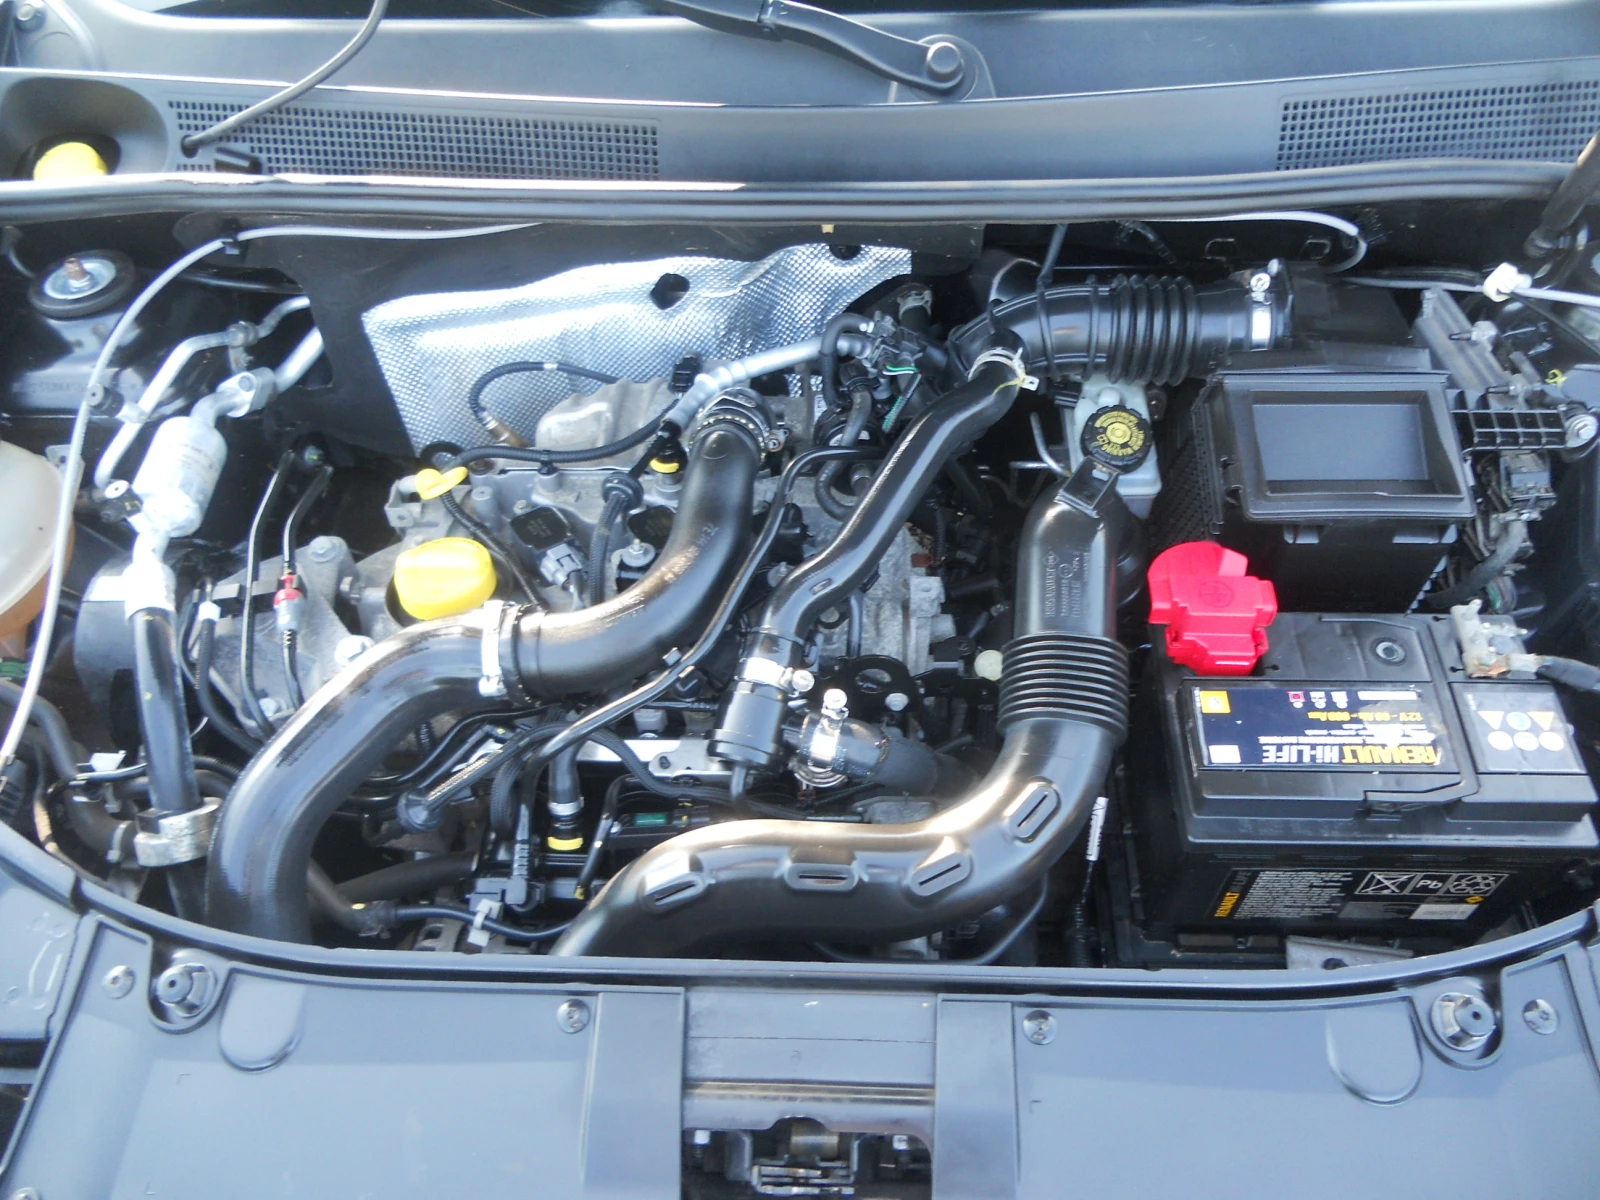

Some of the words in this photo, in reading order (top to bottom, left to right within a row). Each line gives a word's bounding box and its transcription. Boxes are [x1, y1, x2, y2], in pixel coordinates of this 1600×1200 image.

[1262, 745, 1340, 763] Hi-LIFE
[1341, 745, 1437, 764] RENAULT
[1415, 880, 1443, 889] Pb
[1214, 892, 1240, 917] RENAULT
